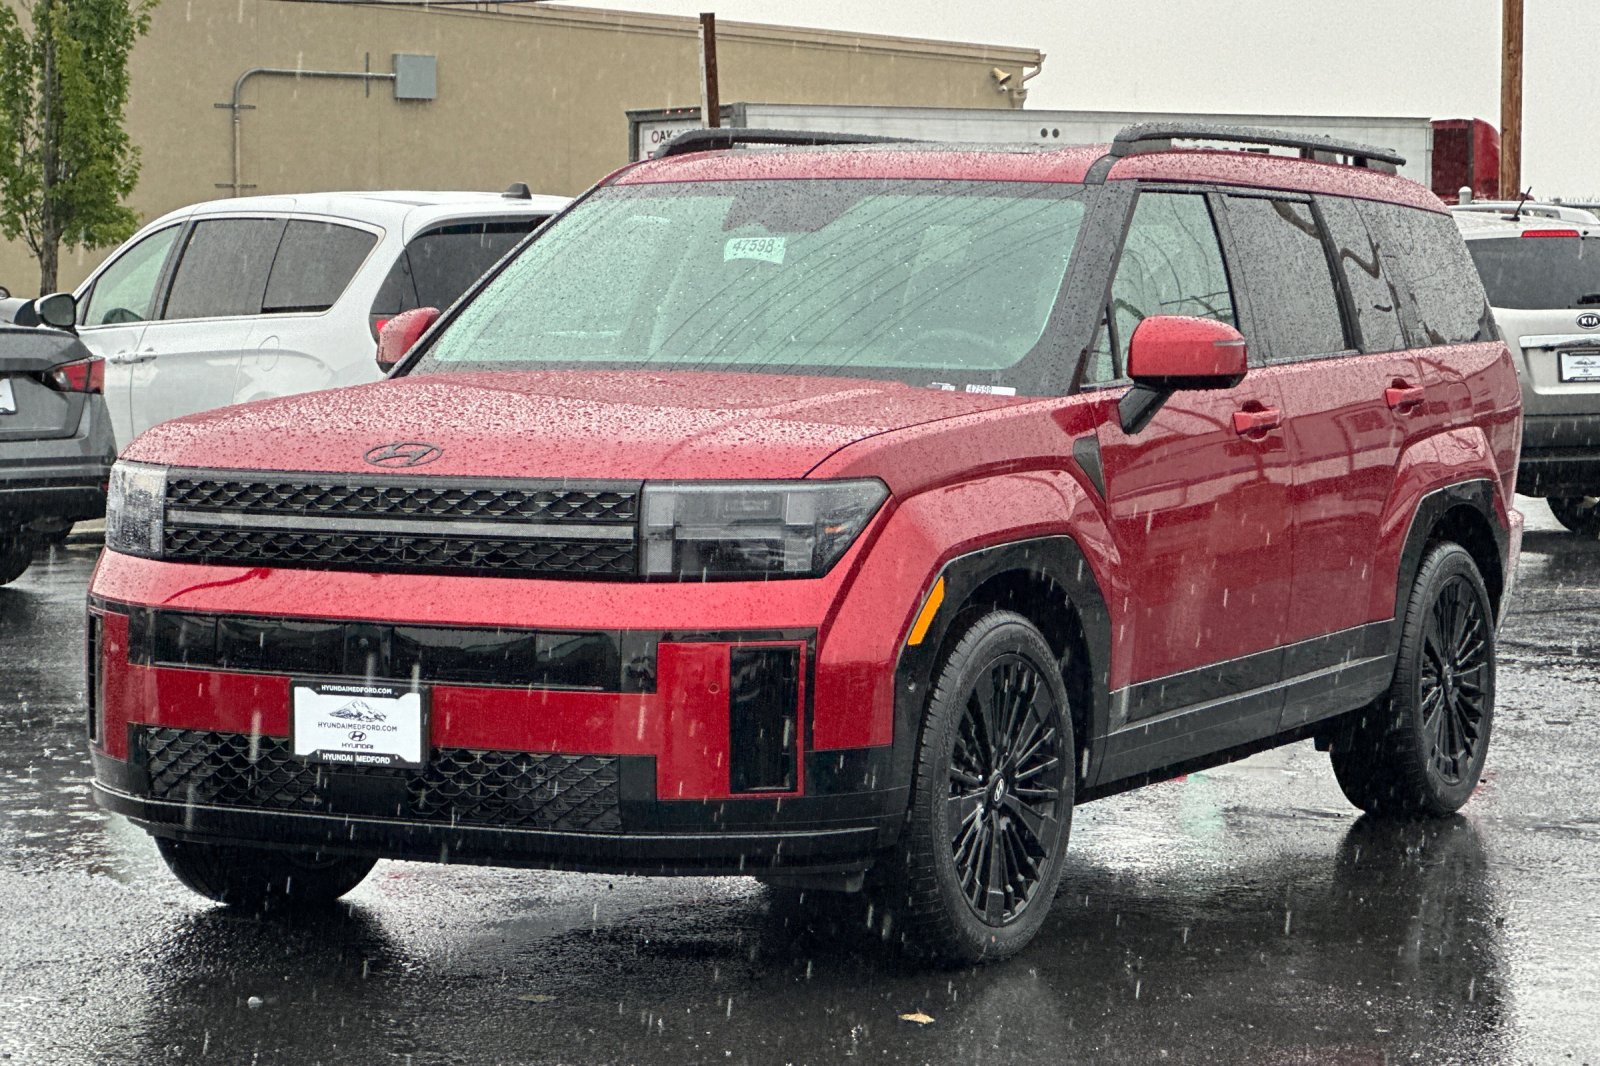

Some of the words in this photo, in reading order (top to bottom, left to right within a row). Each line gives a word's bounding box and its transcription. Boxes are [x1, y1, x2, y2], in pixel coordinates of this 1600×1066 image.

[732, 238, 775, 254] 47598
[1581, 317, 1599, 326] KIA
[321, 684, 393, 695] HYUNDAIMEDFORD.COM
[317, 721, 398, 732] HYUNDAIMEDFORD.COM
[341, 742, 374, 750] HYUNDAI
[322, 752, 354, 762] HYUNDAI
[356, 754, 391, 764] MEDFORD
